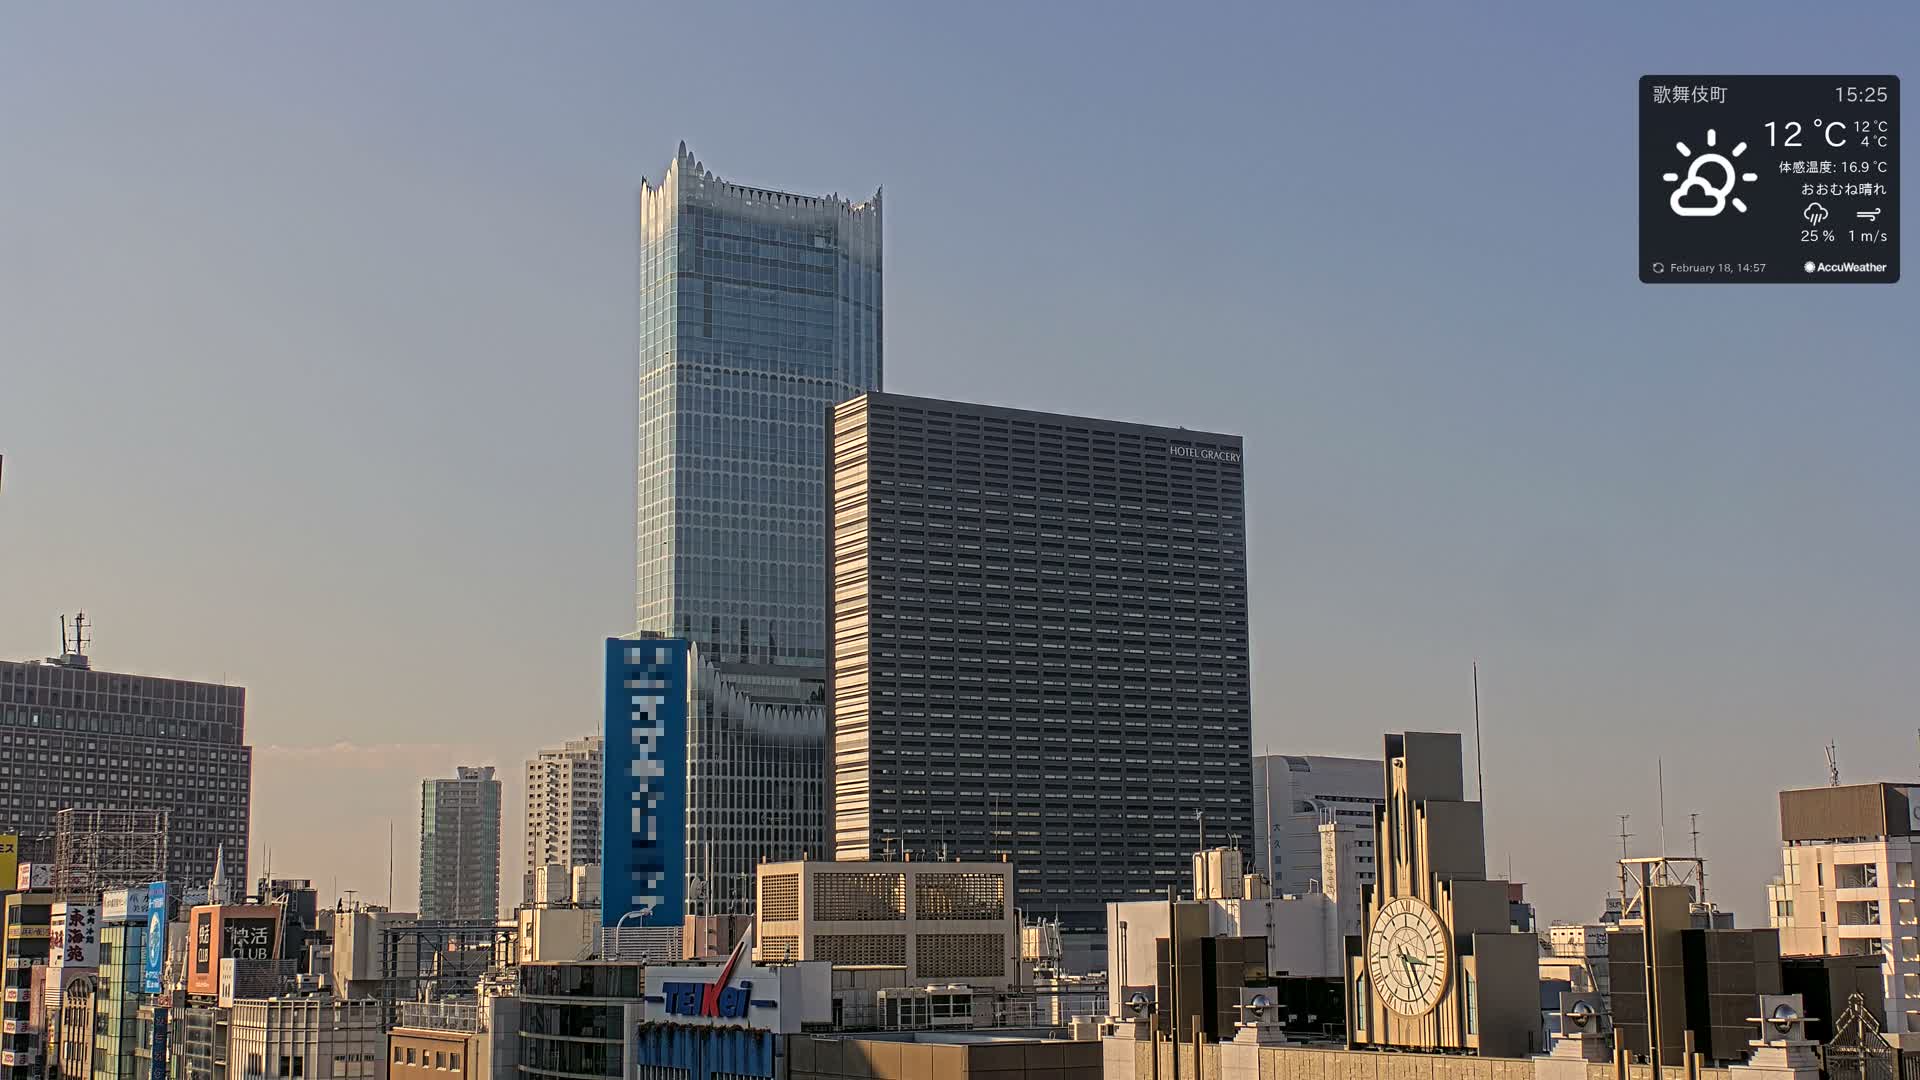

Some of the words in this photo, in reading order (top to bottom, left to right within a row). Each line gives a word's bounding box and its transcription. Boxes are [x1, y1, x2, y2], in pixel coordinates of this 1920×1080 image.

[1170, 445, 1199, 458] HOTEL
[1200, 449, 1241, 462] GRACERY
[64, 908, 85, 962] 東海苑
[233, 927, 268, 945] 快活
[232, 948, 268, 960] CLUB
